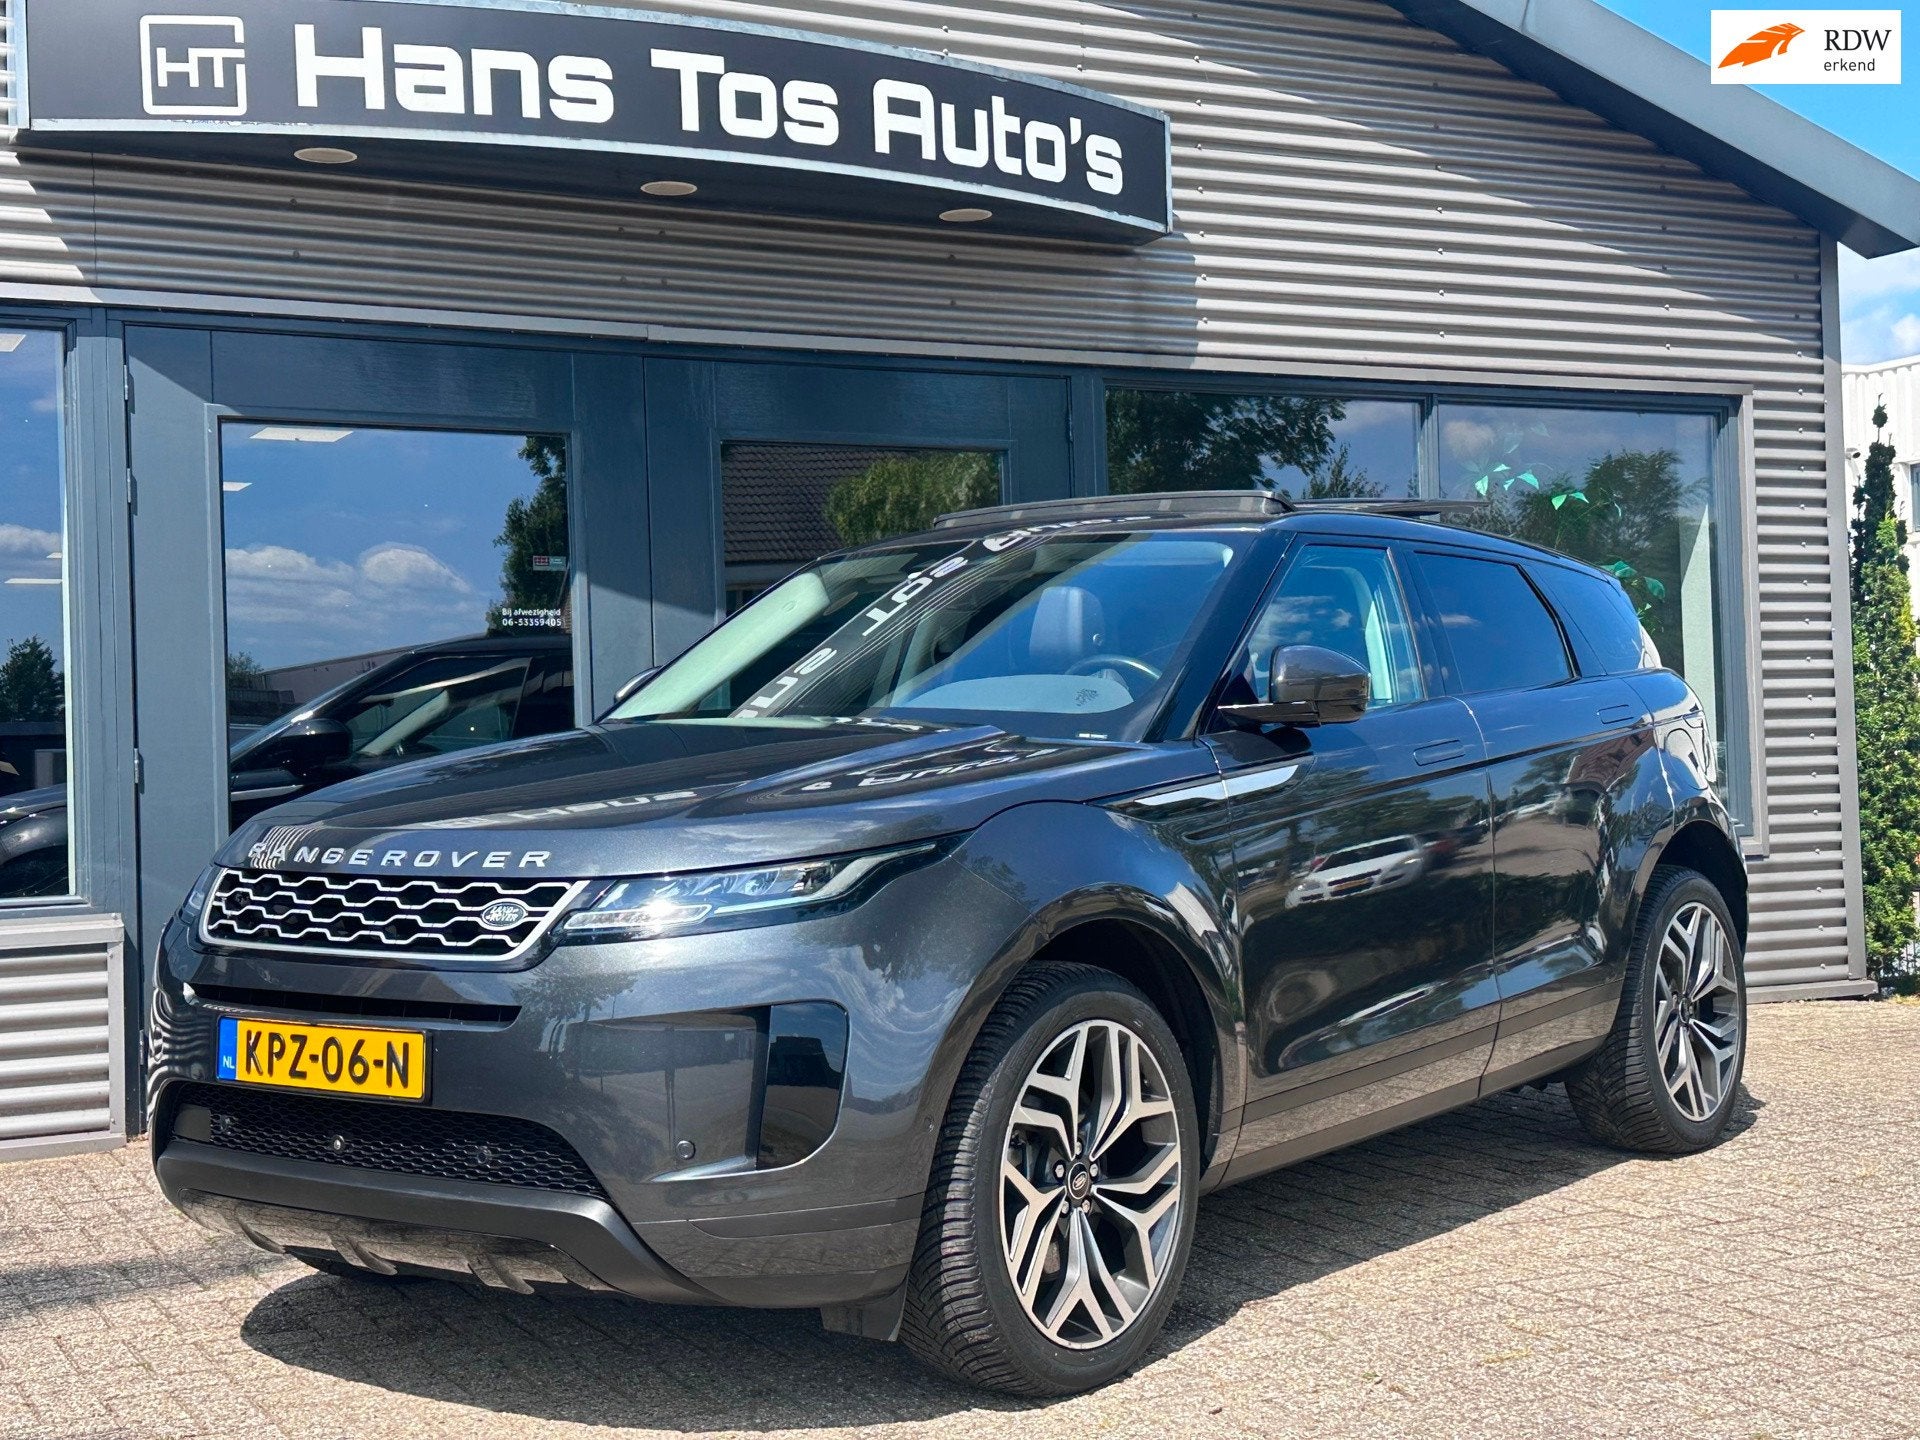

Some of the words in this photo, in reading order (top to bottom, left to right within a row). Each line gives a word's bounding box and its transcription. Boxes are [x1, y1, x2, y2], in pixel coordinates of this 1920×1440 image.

[294, 23, 615, 124] Hans
[650, 48, 840, 146] Tos
[872, 78, 1124, 196] Auto's
[501, 607, 512, 617] Bij
[513, 607, 561, 617] afwezigheid
[222, 1055, 236, 1070] NL
[245, 1029, 410, 1089] KPZ-06-N
